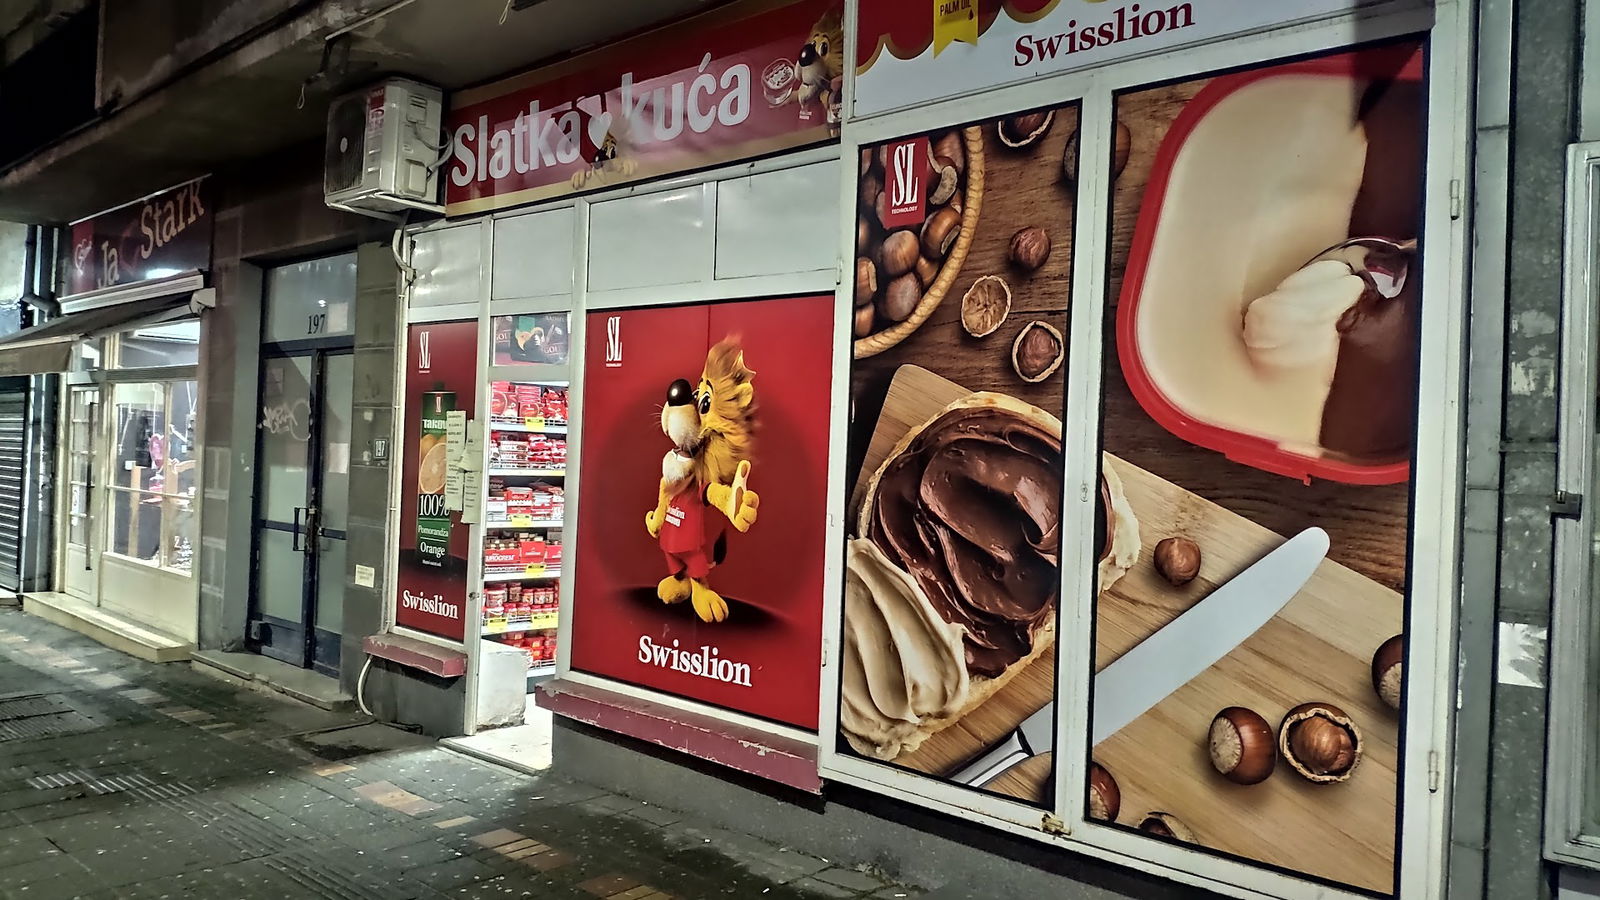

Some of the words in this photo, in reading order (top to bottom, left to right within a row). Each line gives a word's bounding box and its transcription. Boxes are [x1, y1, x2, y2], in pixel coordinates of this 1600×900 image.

[939, 0, 960, 16] PALM
[1014, 2, 1196, 67] Swisslion
[451, 100, 581, 188] Slatka
[621, 52, 752, 145] kuća
[892, 142, 919, 207] SL
[891, 206, 918, 215] TECHNOLOGY
[97, 240, 120, 289] Ja
[307, 313, 326, 335] 197
[606, 316, 623, 362] SL
[419, 331, 431, 369] SL
[419, 494, 450, 517] 100%
[420, 541, 446, 559] Orange
[403, 590, 459, 620] Swisslion
[638, 635, 753, 687] Swisslion
